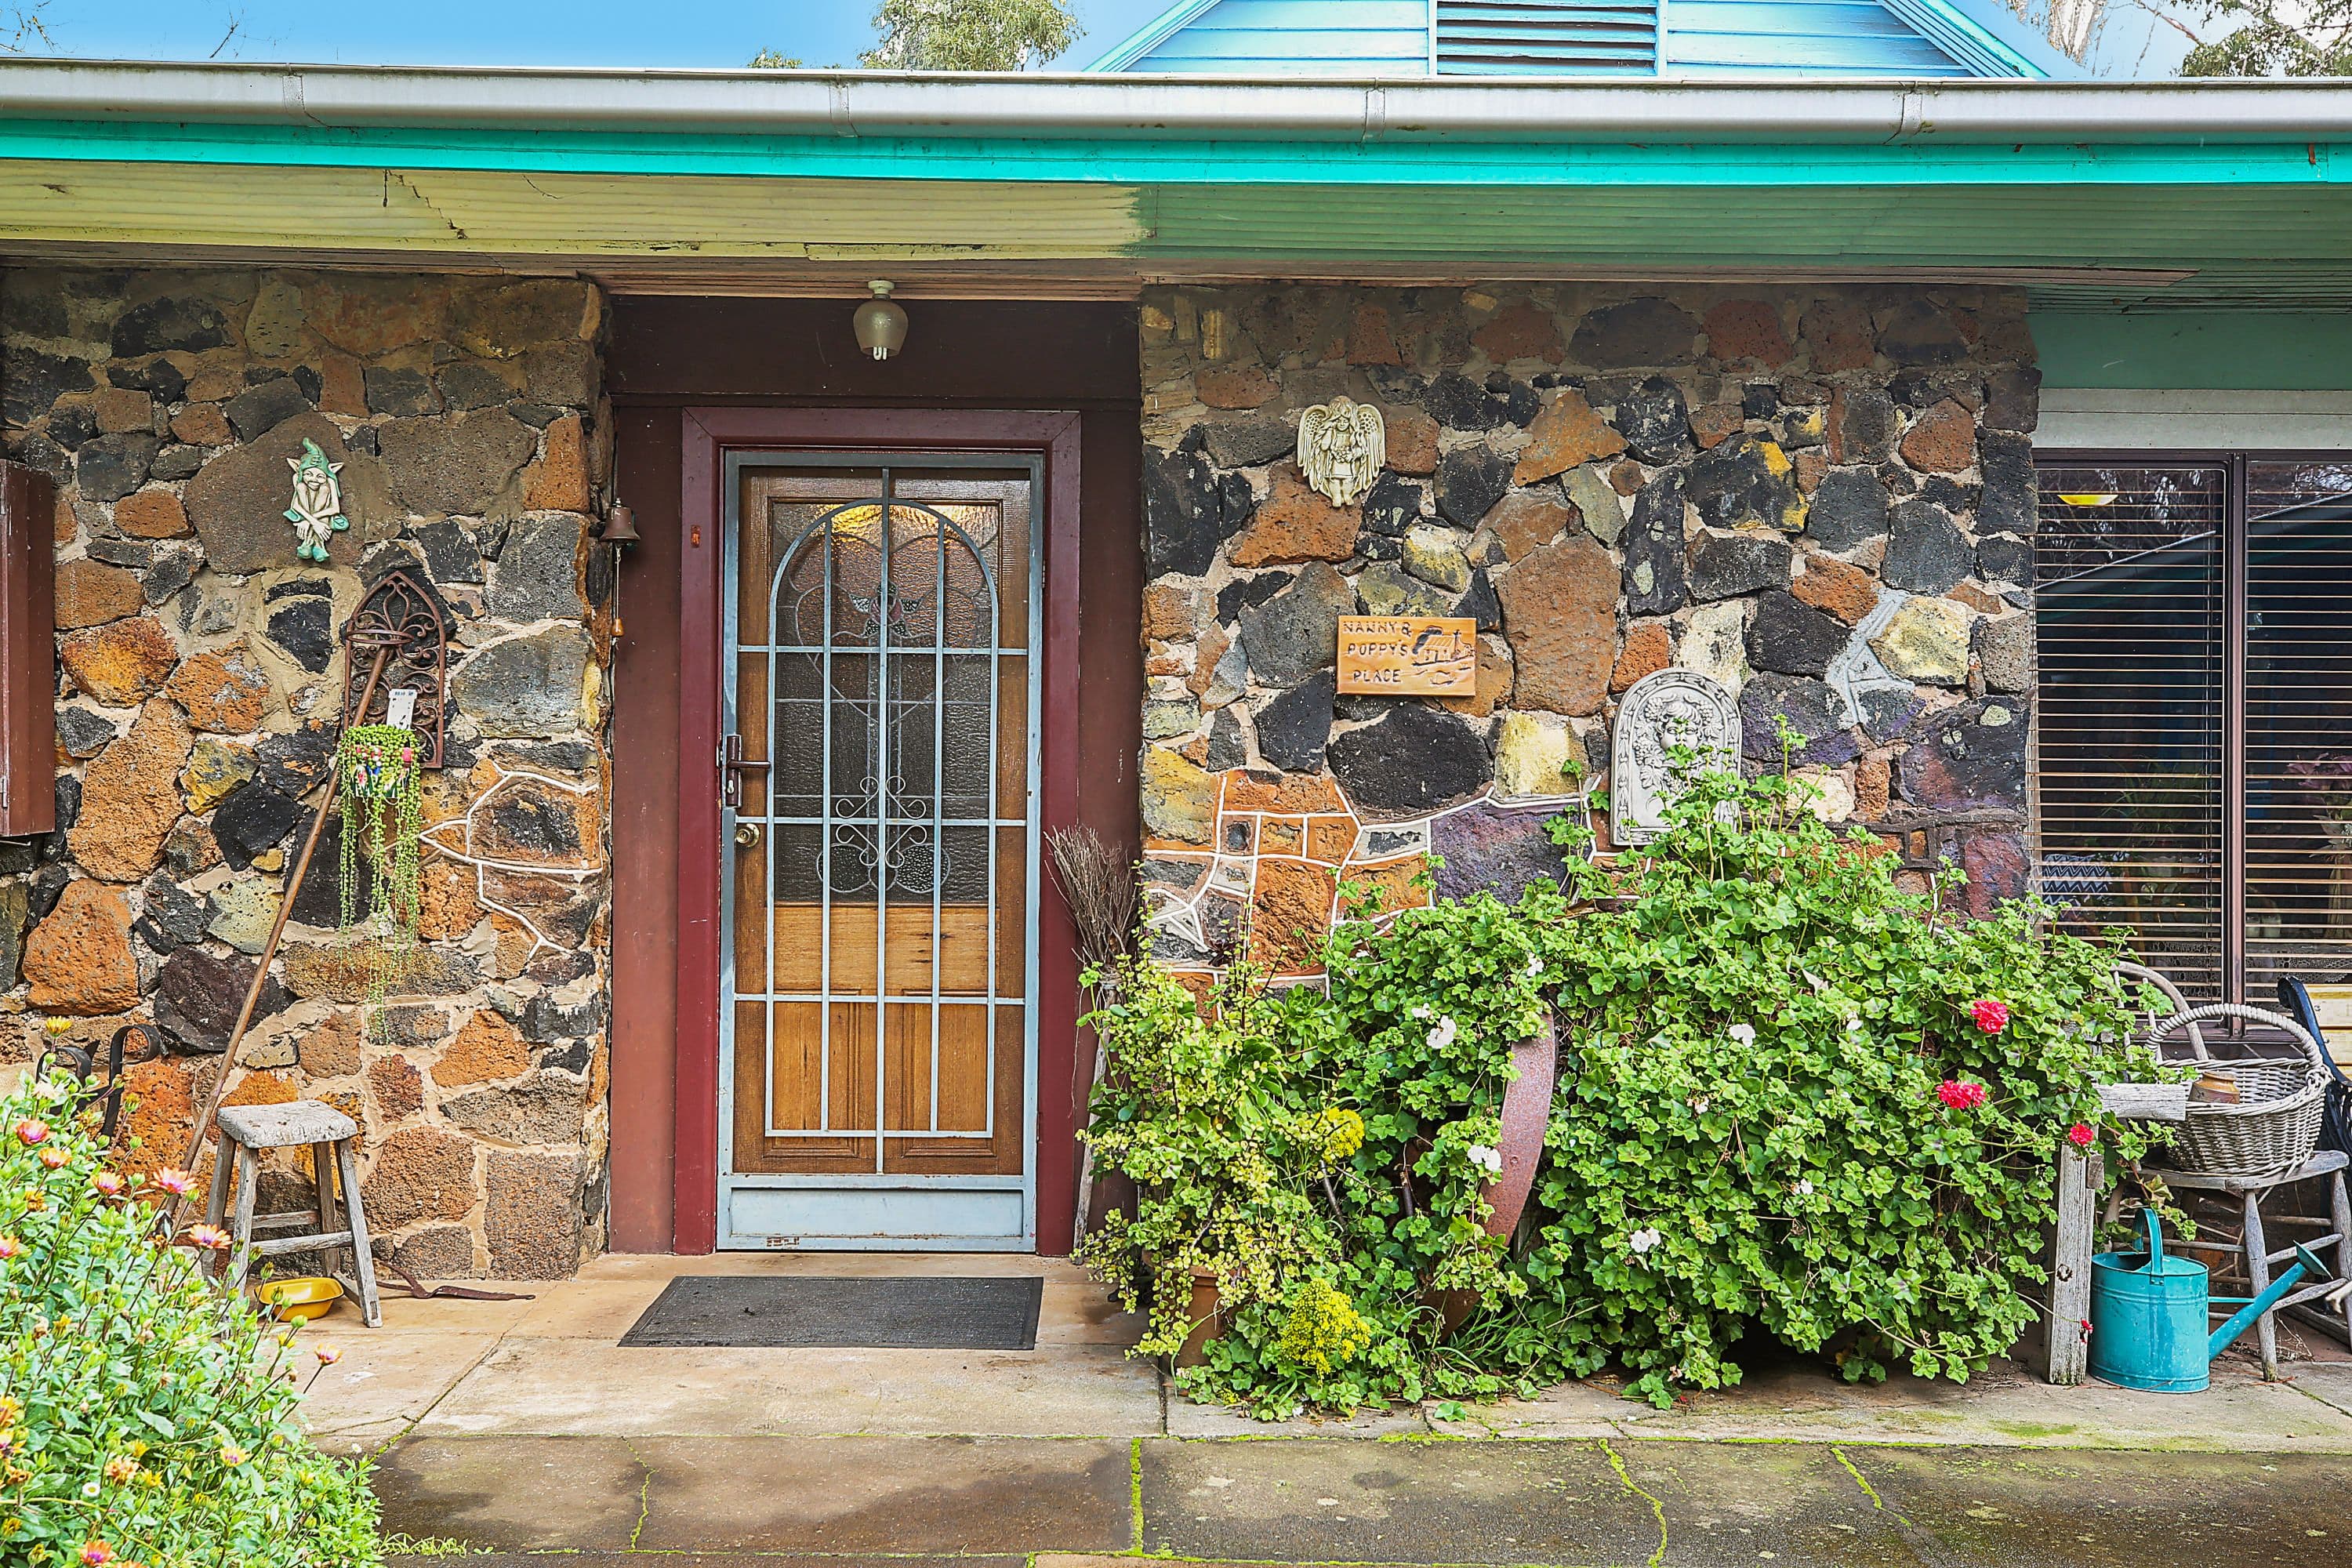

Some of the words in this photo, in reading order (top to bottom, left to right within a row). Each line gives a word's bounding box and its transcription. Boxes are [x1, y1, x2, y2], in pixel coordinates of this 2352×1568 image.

[1342, 621, 1397, 633] NANNY
[1401, 621, 1412, 637] &
[1348, 639, 1409, 657] POPPY'S
[1353, 668, 1402, 683] PLACE
